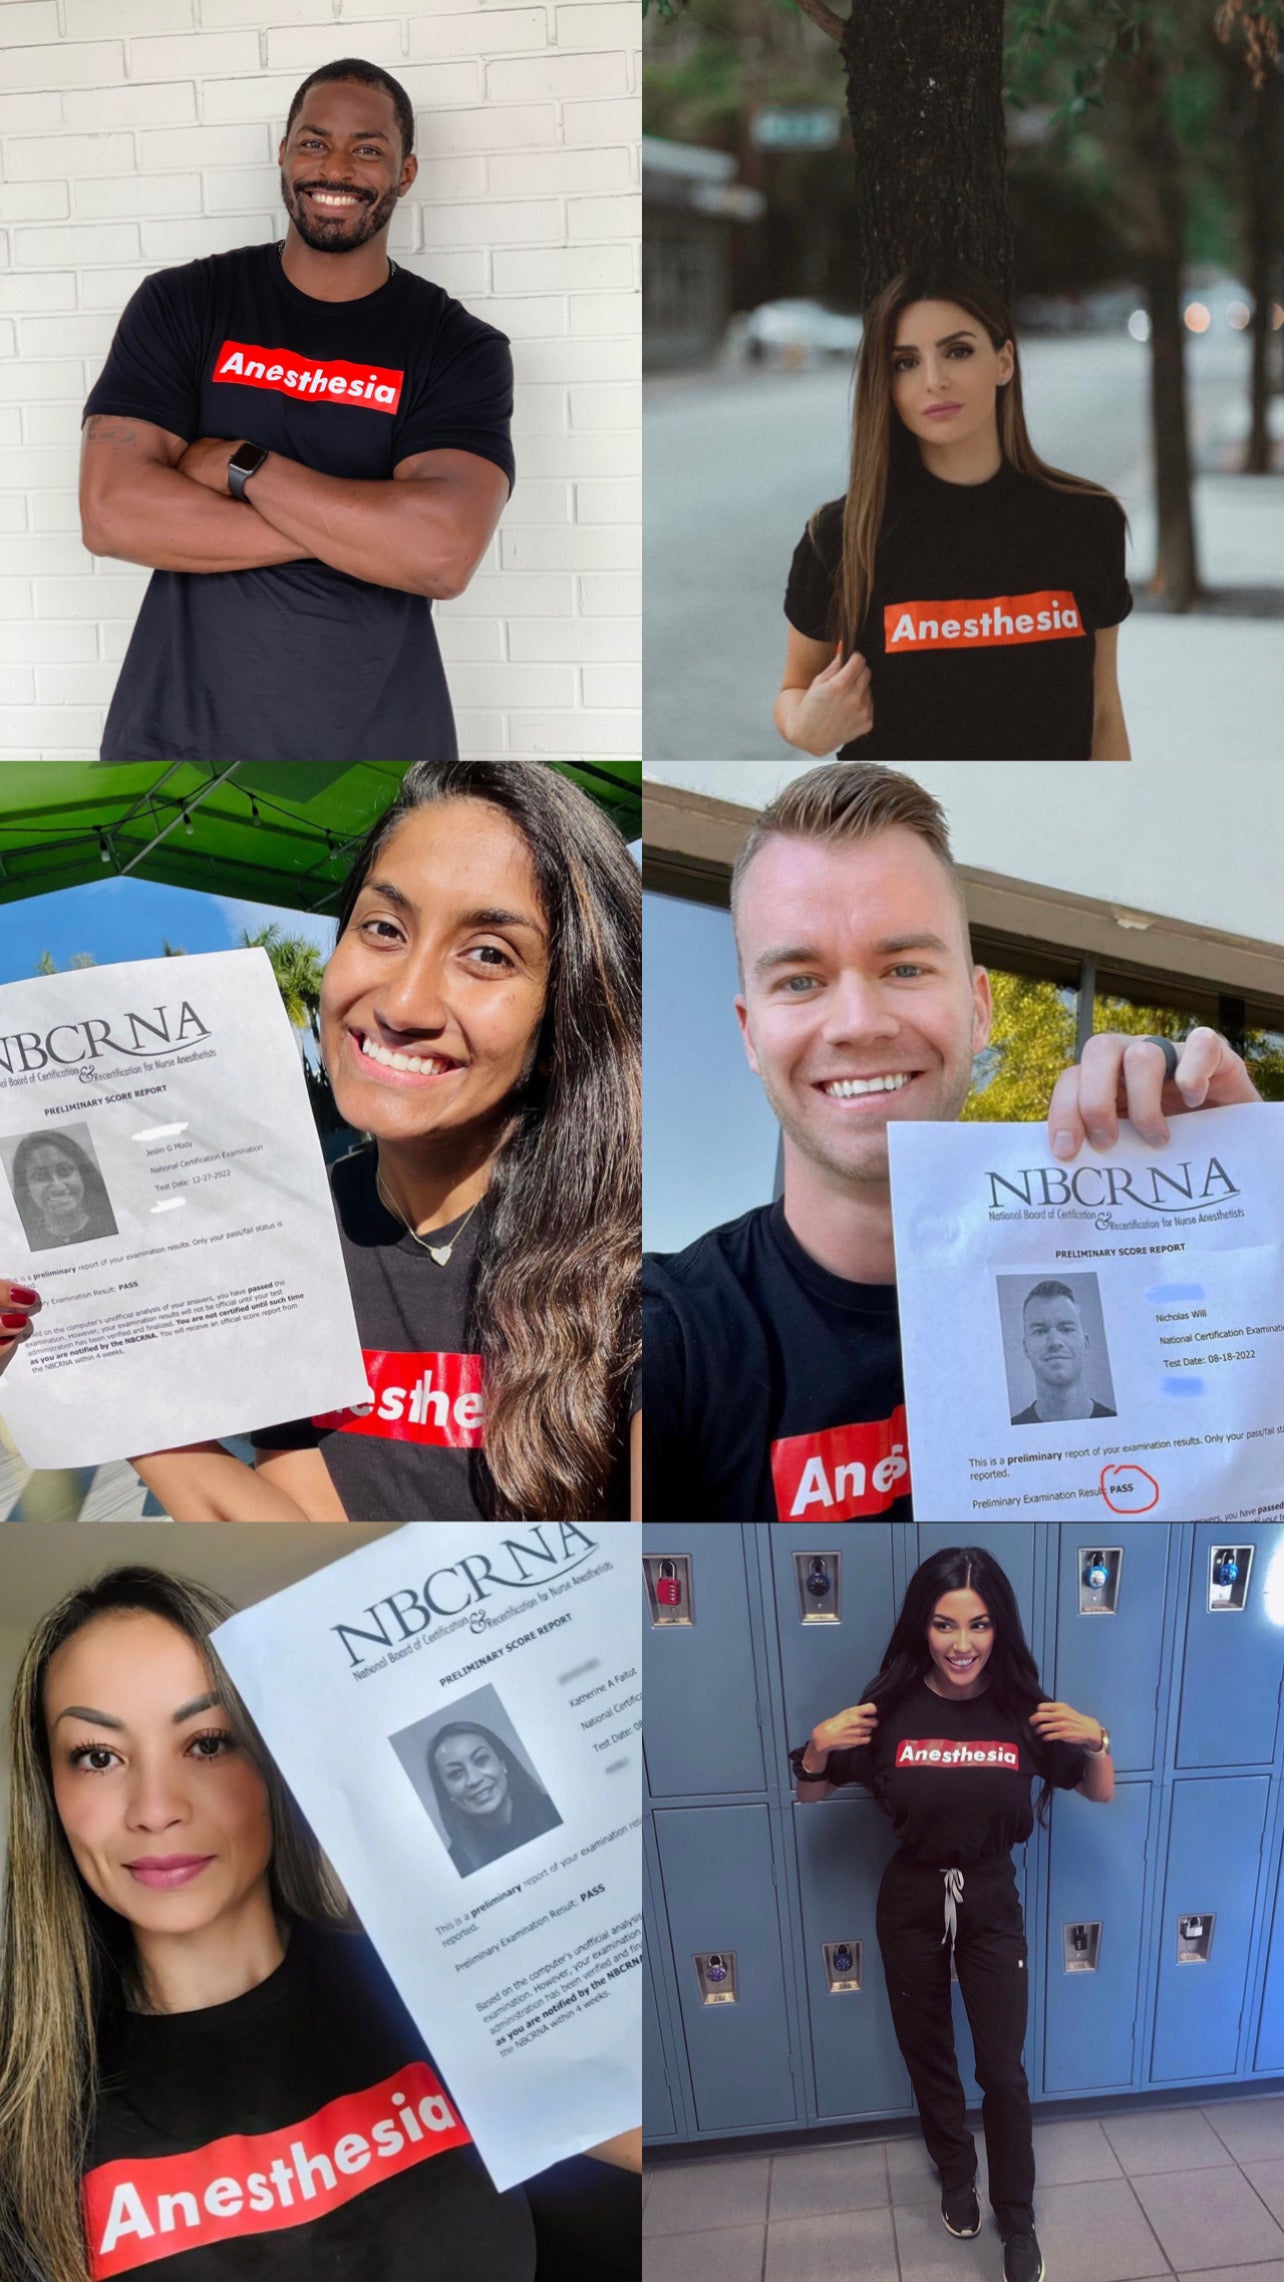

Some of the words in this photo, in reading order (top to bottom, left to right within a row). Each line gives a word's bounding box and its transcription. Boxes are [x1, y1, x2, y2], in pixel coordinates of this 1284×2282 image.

[219, 352, 396, 404] Anesthesia
[891, 599, 1078, 643] Anesthesia
[0, 1001, 212, 1074] BCRNA
[8, 1075, 28, 1087] Board
[28, 1073, 36, 1084] of
[37, 1067, 80, 1081] Certification
[79, 1064, 95, 1083] &
[92, 1066, 142, 1082] Recertification
[143, 1062, 153, 1071] for
[154, 1059, 175, 1069] Nurse
[176, 1050, 217, 1064] Anesthetists
[44, 1098, 102, 1115] PRELIMINARY
[105, 1092, 132, 1103] SCORE
[134, 1084, 166, 1097] REPORT
[150, 1162, 178, 1174] National
[179, 1153, 221, 1167] Certification
[221, 1145, 263, 1159] Examination
[154, 1183, 170, 1191] Test
[985, 1157, 1241, 1212] NBCRNA
[988, 1209, 1022, 1221] National
[1023, 1209, 1046, 1220] Board
[1047, 1208, 1055, 1219] of
[1057, 1208, 1096, 1219] Certification
[1095, 1212, 1112, 1231] &
[1109, 1219, 1160, 1230] Recertification
[1161, 1217, 1172, 1227] for
[1174, 1216, 1197, 1226] Nurse
[1198, 1209, 1245, 1222] Anesthetists
[33, 1267, 76, 1280] preliminary
[78, 1261, 99, 1270] report
[100, 1258, 107, 1266] of
[109, 1256, 124, 1265] your
[126, 1247, 166, 1260] examination
[191, 1237, 208, 1246] Only
[209, 1234, 224, 1243] your
[226, 1226, 254, 1239] pass/fail
[255, 1223, 276, 1232] status
[1055, 1249, 1116, 1258] PRELIMINARY
[1118, 1246, 1147, 1256] SCORE
[1149, 1243, 1185, 1253] REPORT
[50, 1292, 92, 1304] Examination
[92, 1287, 115, 1296] Result:
[118, 1281, 139, 1290] PASS
[218, 1305, 249, 1316] certified
[251, 1300, 268, 1310] until
[269, 1297, 286, 1305] such
[287, 1293, 304, 1301] time
[1155, 1312, 1189, 1322] Nicholas
[1190, 1309, 1207, 1318] Will
[1159, 1334, 1192, 1344] National
[1194, 1329, 1244, 1341] Certification
[1245, 1324, 1284, 1335] Examinati
[40, 1355, 55, 1364] you
[69, 1345, 99, 1356] notified
[1162, 1359, 1181, 1368] Test
[1182, 1357, 1206, 1366] Date:
[1208, 1349, 1256, 1363] 08-18-2022
[968, 1458, 988, 1467] This
[989, 1457, 997, 1466] is
[999, 1457, 1005, 1465] a
[1007, 1452, 1062, 1465] preliminary
[1064, 1448, 1090, 1459] report
[1092, 1446, 1100, 1456] of
[1102, 1446, 1120, 1456] your
[1122, 1441, 1171, 1452] examination
[1173, 1436, 1203, 1447] results.
[1204, 1434, 1224, 1444] Only
[1225, 1432, 1244, 1443] your
[1246, 1427, 1275, 1440] pass/fail
[970, 1469, 1010, 1482] reported.
[972, 1497, 1021, 1509] Preliminary
[1023, 1491, 1076, 1504] Examination
[1109, 1483, 1134, 1493] PASS
[1239, 1508, 1256, 1517] have
[330, 1522, 599, 1667] NBCRNA
[352, 1657, 388, 1681] National
[387, 1645, 413, 1663] Board
[413, 1637, 422, 1650] of
[422, 1617, 469, 1645] Certification
[468, 1609, 487, 1634] &
[485, 1599, 538, 1628] Recertification
[537, 1592, 549, 1602] for
[548, 1581, 572, 1597] Nurse
[571, 1562, 613, 1585] Anesthetists
[439, 1648, 503, 1686] PRELIMINARY
[505, 1631, 536, 1652] SCORE
[537, 1613, 571, 1635] REPORT
[569, 1684, 606, 1707] Katherine
[607, 1679, 615, 1688] A
[580, 1708, 613, 1730] National
[592, 1739, 612, 1752] Test
[610, 1727, 633, 1743] Date:
[899, 1745, 1016, 1764] Anesthesia
[435, 1922, 454, 1935] This
[454, 1917, 463, 1926] is
[464, 1913, 470, 1921] a
[470, 1884, 522, 1918] preliminary
[523, 1869, 549, 1887] report
[549, 1861, 559, 1873] of
[560, 1853, 578, 1868] your
[580, 1826, 628, 1856] examination
[442, 1924, 479, 1947] reported.
[454, 1944, 500, 1972] Preliminary
[500, 1915, 549, 1947] Examination
[549, 1900, 578, 1918] Result:
[580, 1884, 605, 1902] PASS
[475, 1992, 501, 2011] Based
[501, 1986, 513, 1997] on
[512, 1978, 528, 1989] the
[529, 1953, 573, 1981] computer's
[573, 1930, 610, 1955] unofficial
[483, 1991, 533, 2023] examination.
[533, 1969, 572, 1992] However,
[572, 1956, 590, 1972] your
[592, 1929, 642, 1959] examination
[490, 1999, 544, 2034] administration
[544, 1989, 561, 2001] has
[560, 1977, 582, 1992] been
[582, 1958, 612, 1979] verified
[613, 1948, 629, 1963] and
[496, 2036, 506, 2046] as
[507, 2026, 525, 2040] you
[526, 2016, 541, 2028] are
[542, 1993, 577, 2018] notified
[577, 1987, 589, 1997] by
[590, 1977, 606, 1990] the
[99, 2093, 456, 2255] Anesthesia
